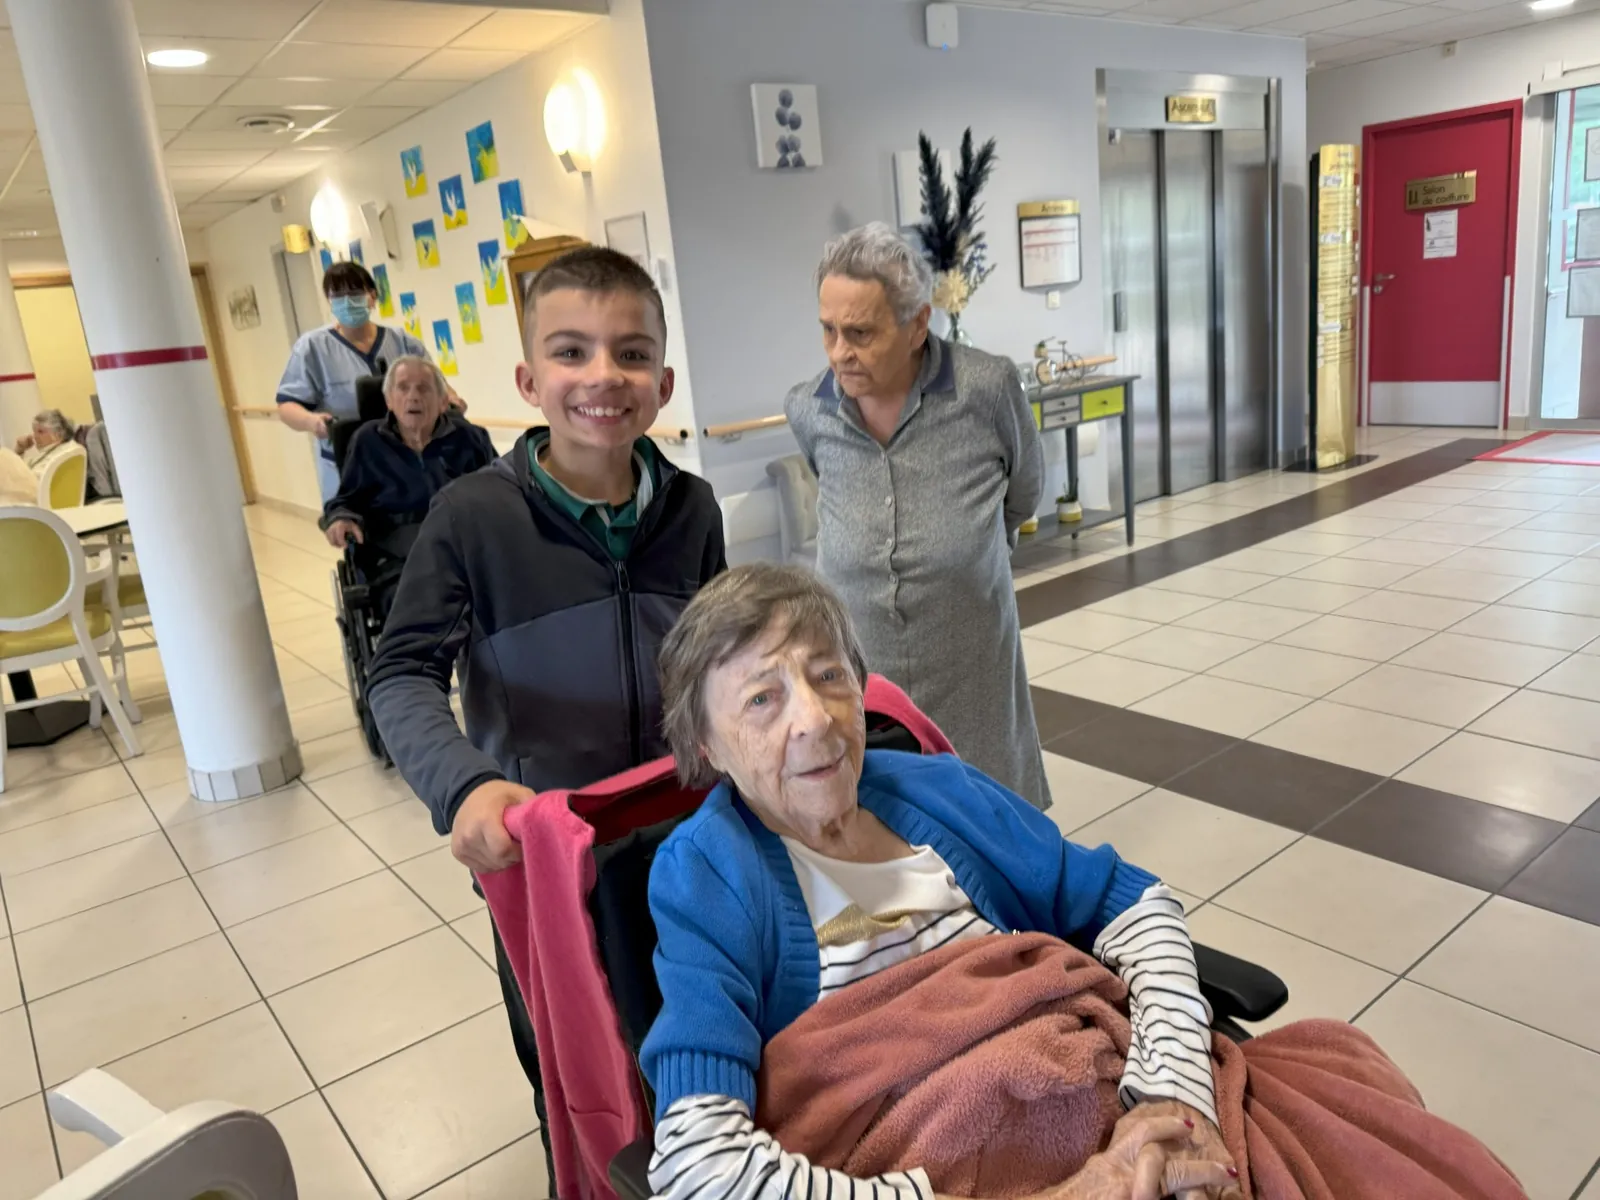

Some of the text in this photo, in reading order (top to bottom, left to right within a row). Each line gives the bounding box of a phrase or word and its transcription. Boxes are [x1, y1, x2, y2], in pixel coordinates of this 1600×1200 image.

[1422, 185, 1445, 196] Salon
[1422, 192, 1470, 205] de coiffure
